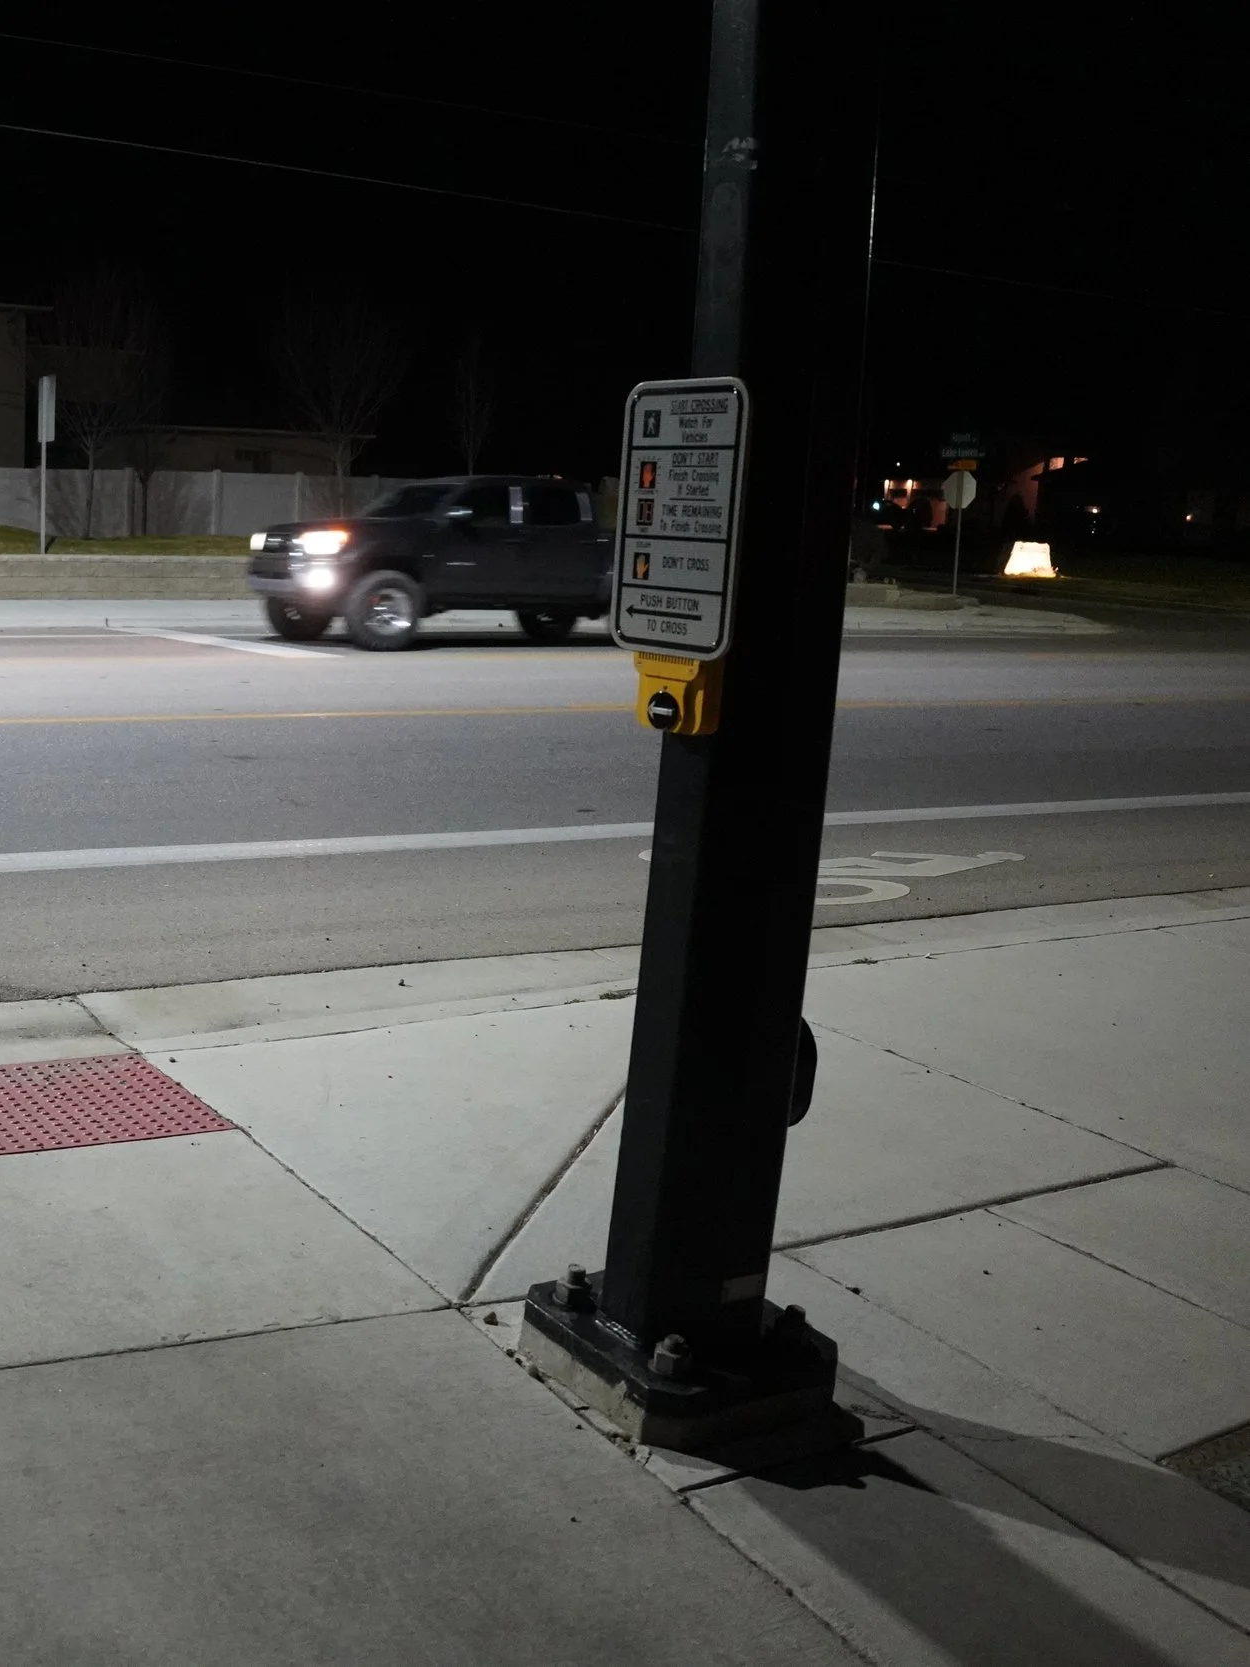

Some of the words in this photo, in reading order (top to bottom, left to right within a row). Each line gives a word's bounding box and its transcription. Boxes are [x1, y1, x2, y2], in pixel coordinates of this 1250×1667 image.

[672, 452, 694, 465] DON'T
[697, 452, 719, 465] START
[669, 469, 689, 481] Finish
[692, 469, 719, 486] Crossing
[686, 483, 709, 496] Started
[662, 504, 678, 517] TIME
[682, 504, 722, 519] REMAINING
[671, 519, 690, 532] Finish
[694, 520, 722, 535] Crossing
[662, 556, 684, 570] DON'T
[687, 557, 710, 572] CROSS
[640, 593, 663, 608] PUSH
[666, 596, 700, 612] BUTTON
[647, 619, 657, 632] TO
[660, 620, 688, 636] CROSS
